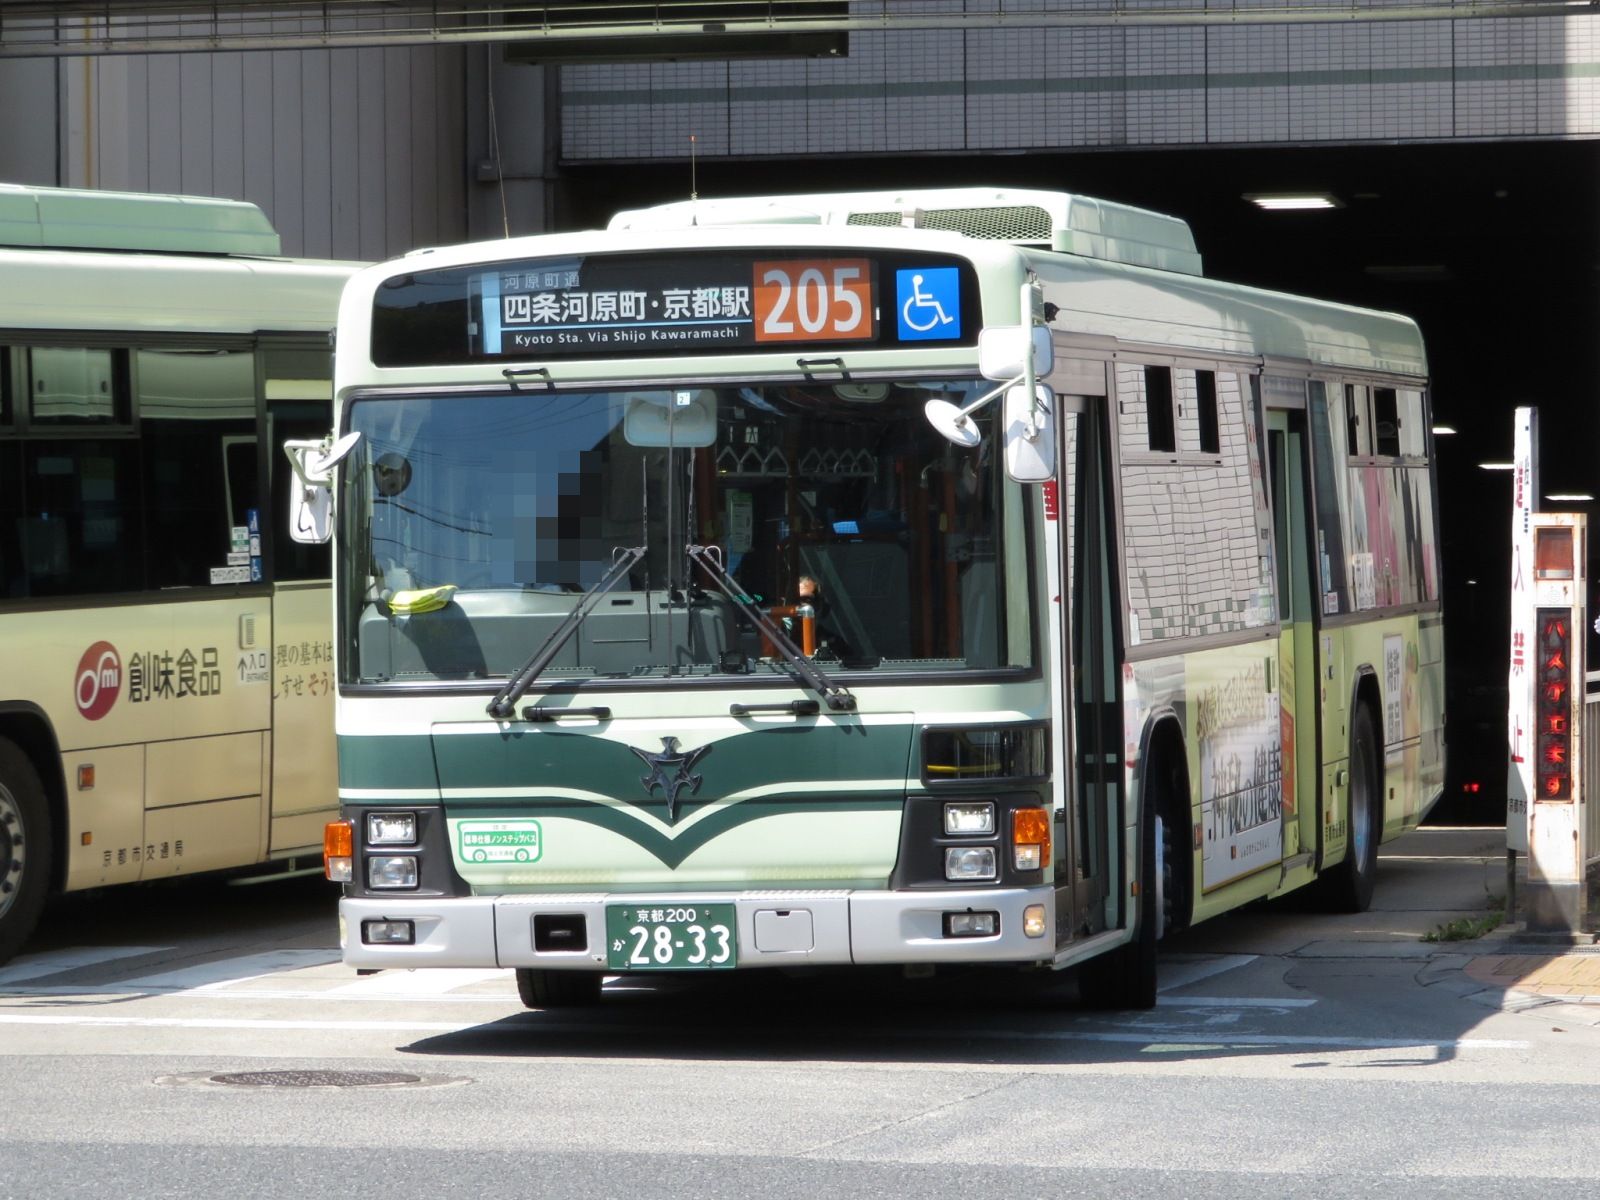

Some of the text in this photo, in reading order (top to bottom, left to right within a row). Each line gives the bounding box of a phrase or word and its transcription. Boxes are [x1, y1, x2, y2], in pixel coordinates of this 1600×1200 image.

[505, 271, 580, 289] 河原町通
[764, 268, 862, 333] 205
[515, 327, 739, 347] Kyoto Sta. Via Shijo Kawaramachi
[249, 653, 266, 670] 入口
[274, 641, 333, 667] 理の基本は
[128, 647, 221, 703] 創味食品
[613, 924, 730, 964] か 28-33
